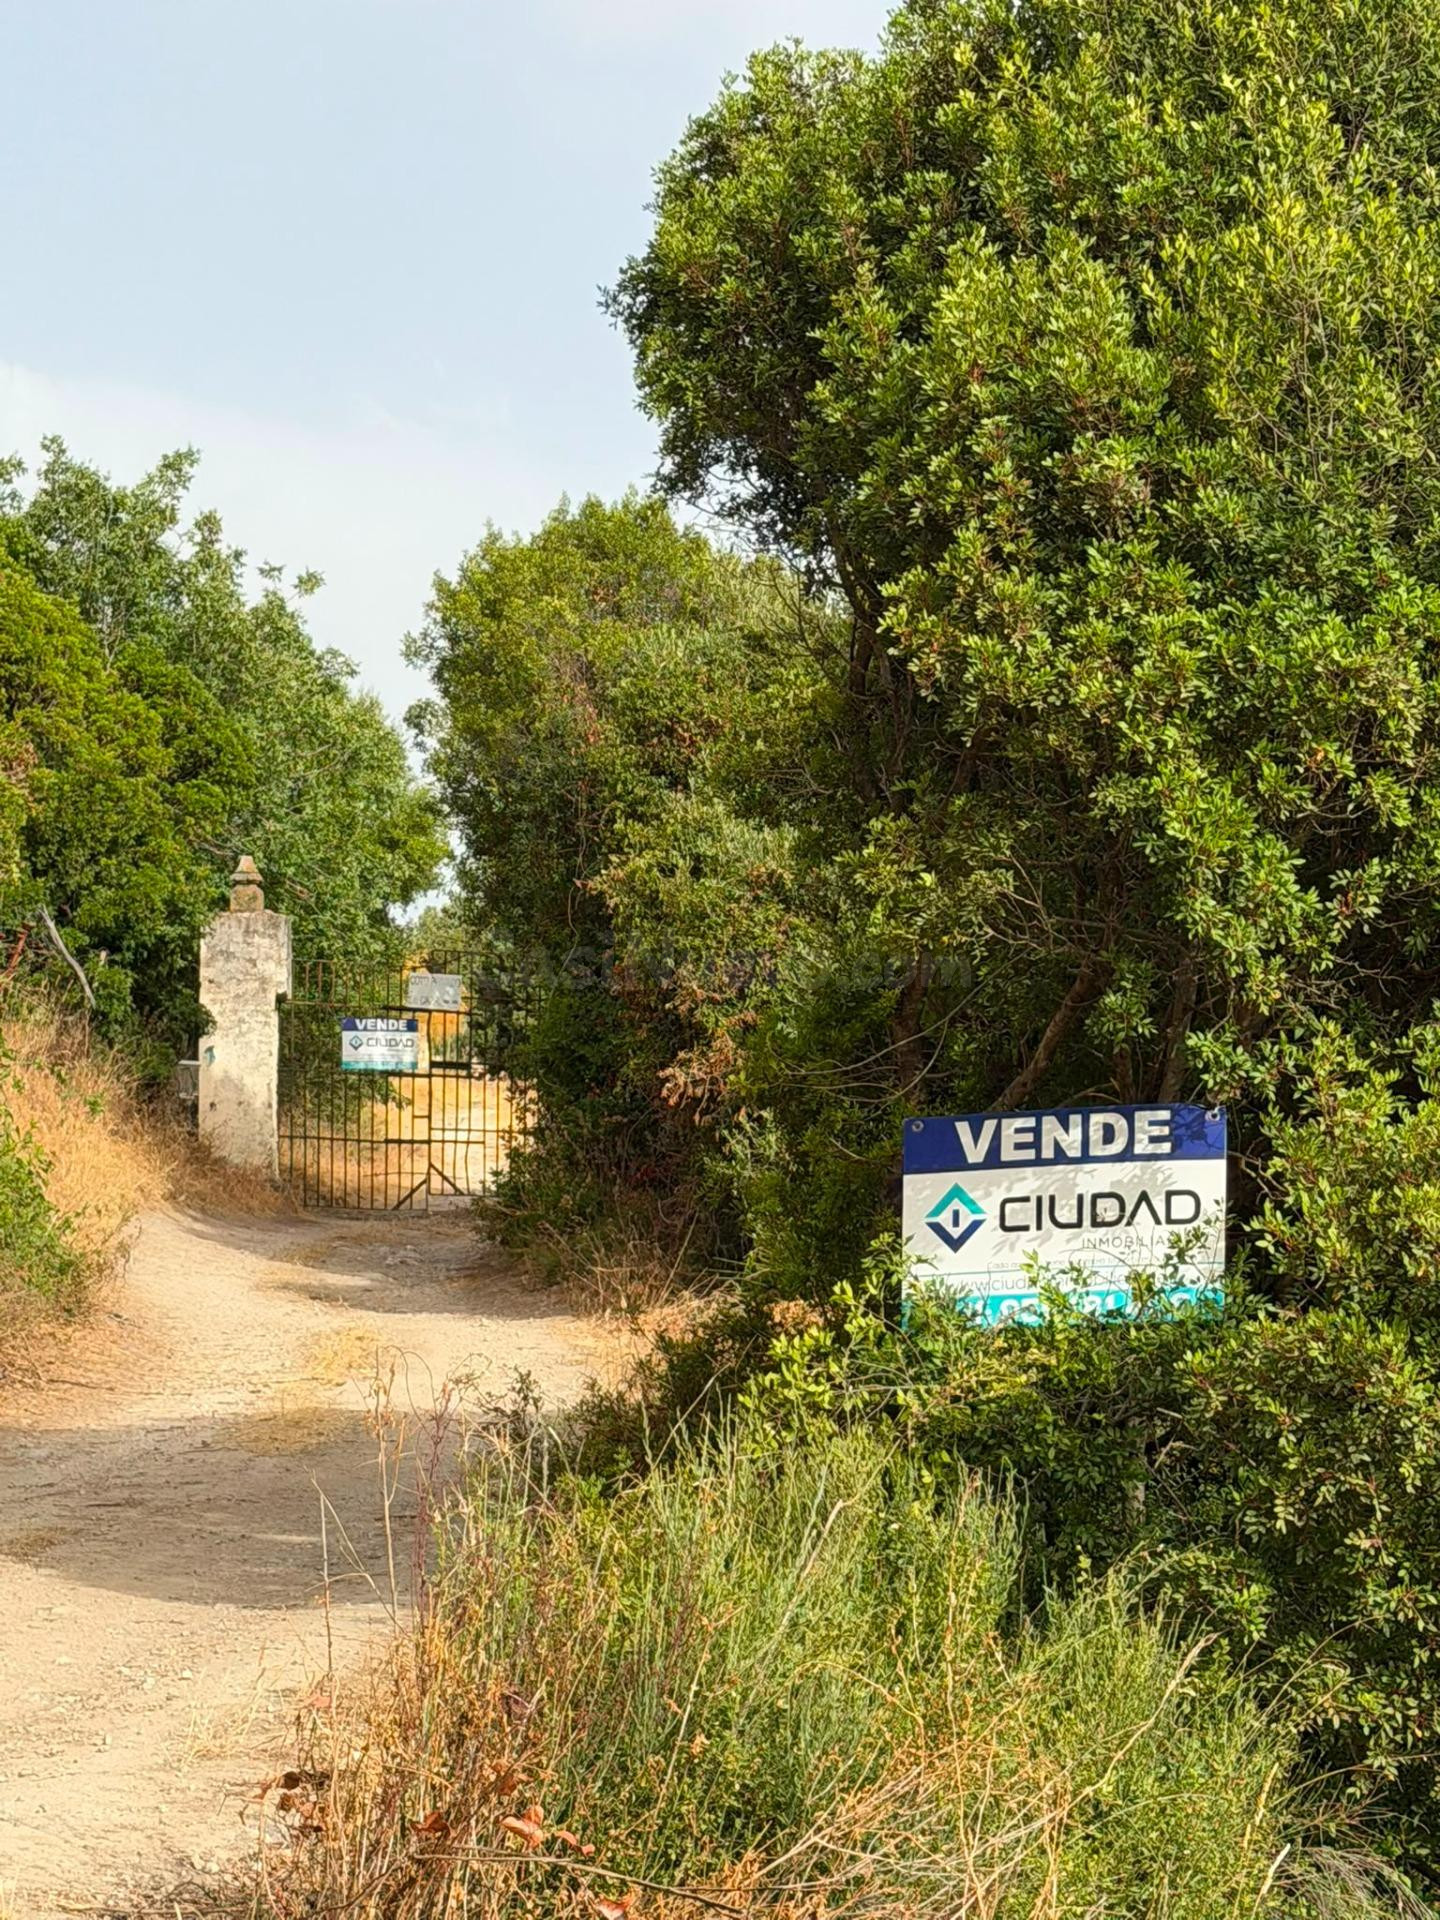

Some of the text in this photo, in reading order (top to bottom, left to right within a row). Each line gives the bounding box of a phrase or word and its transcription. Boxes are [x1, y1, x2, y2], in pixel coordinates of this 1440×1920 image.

[354, 1018, 408, 1031] VENDE
[366, 1037, 415, 1048] CIUDAD
[955, 1109, 1172, 1164] VENDE
[999, 1189, 1202, 1233] CIUDAD
[1082, 1233, 1193, 1250] INMOBILIA
